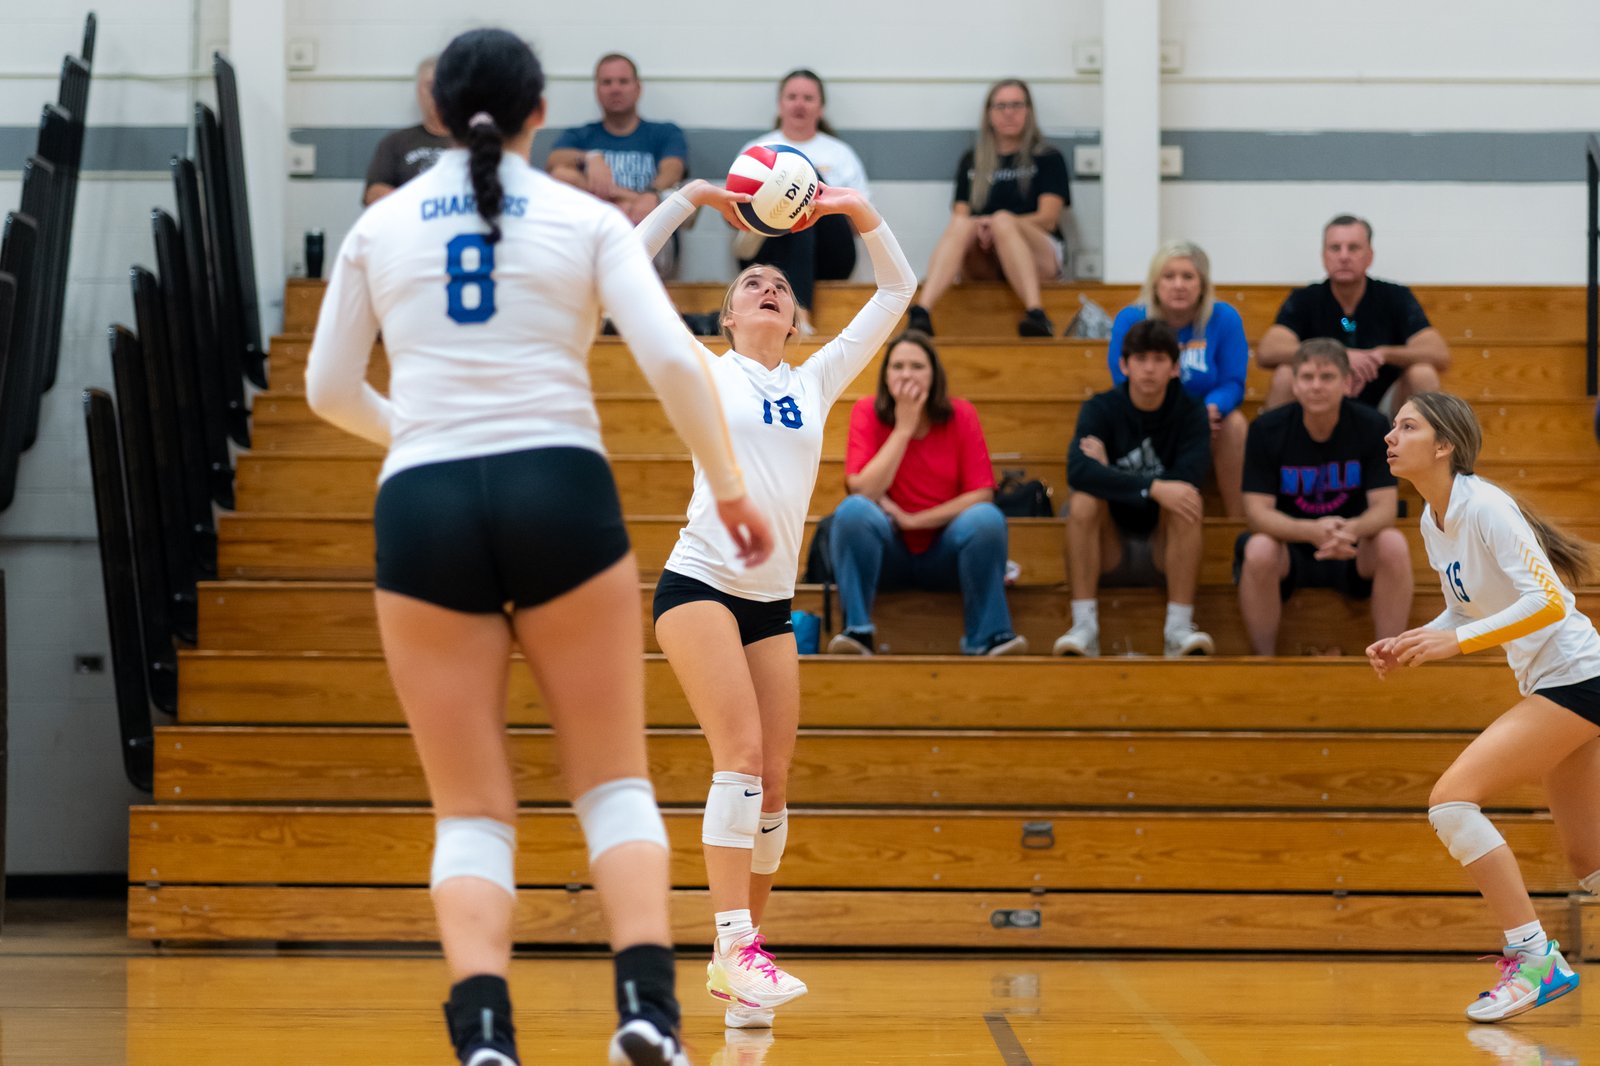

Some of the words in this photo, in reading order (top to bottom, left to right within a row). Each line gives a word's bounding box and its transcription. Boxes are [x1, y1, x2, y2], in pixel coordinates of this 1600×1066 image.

[420, 194, 529, 221] CHARRS
[446, 233, 498, 324] 8
[762, 395, 804, 430] 18
